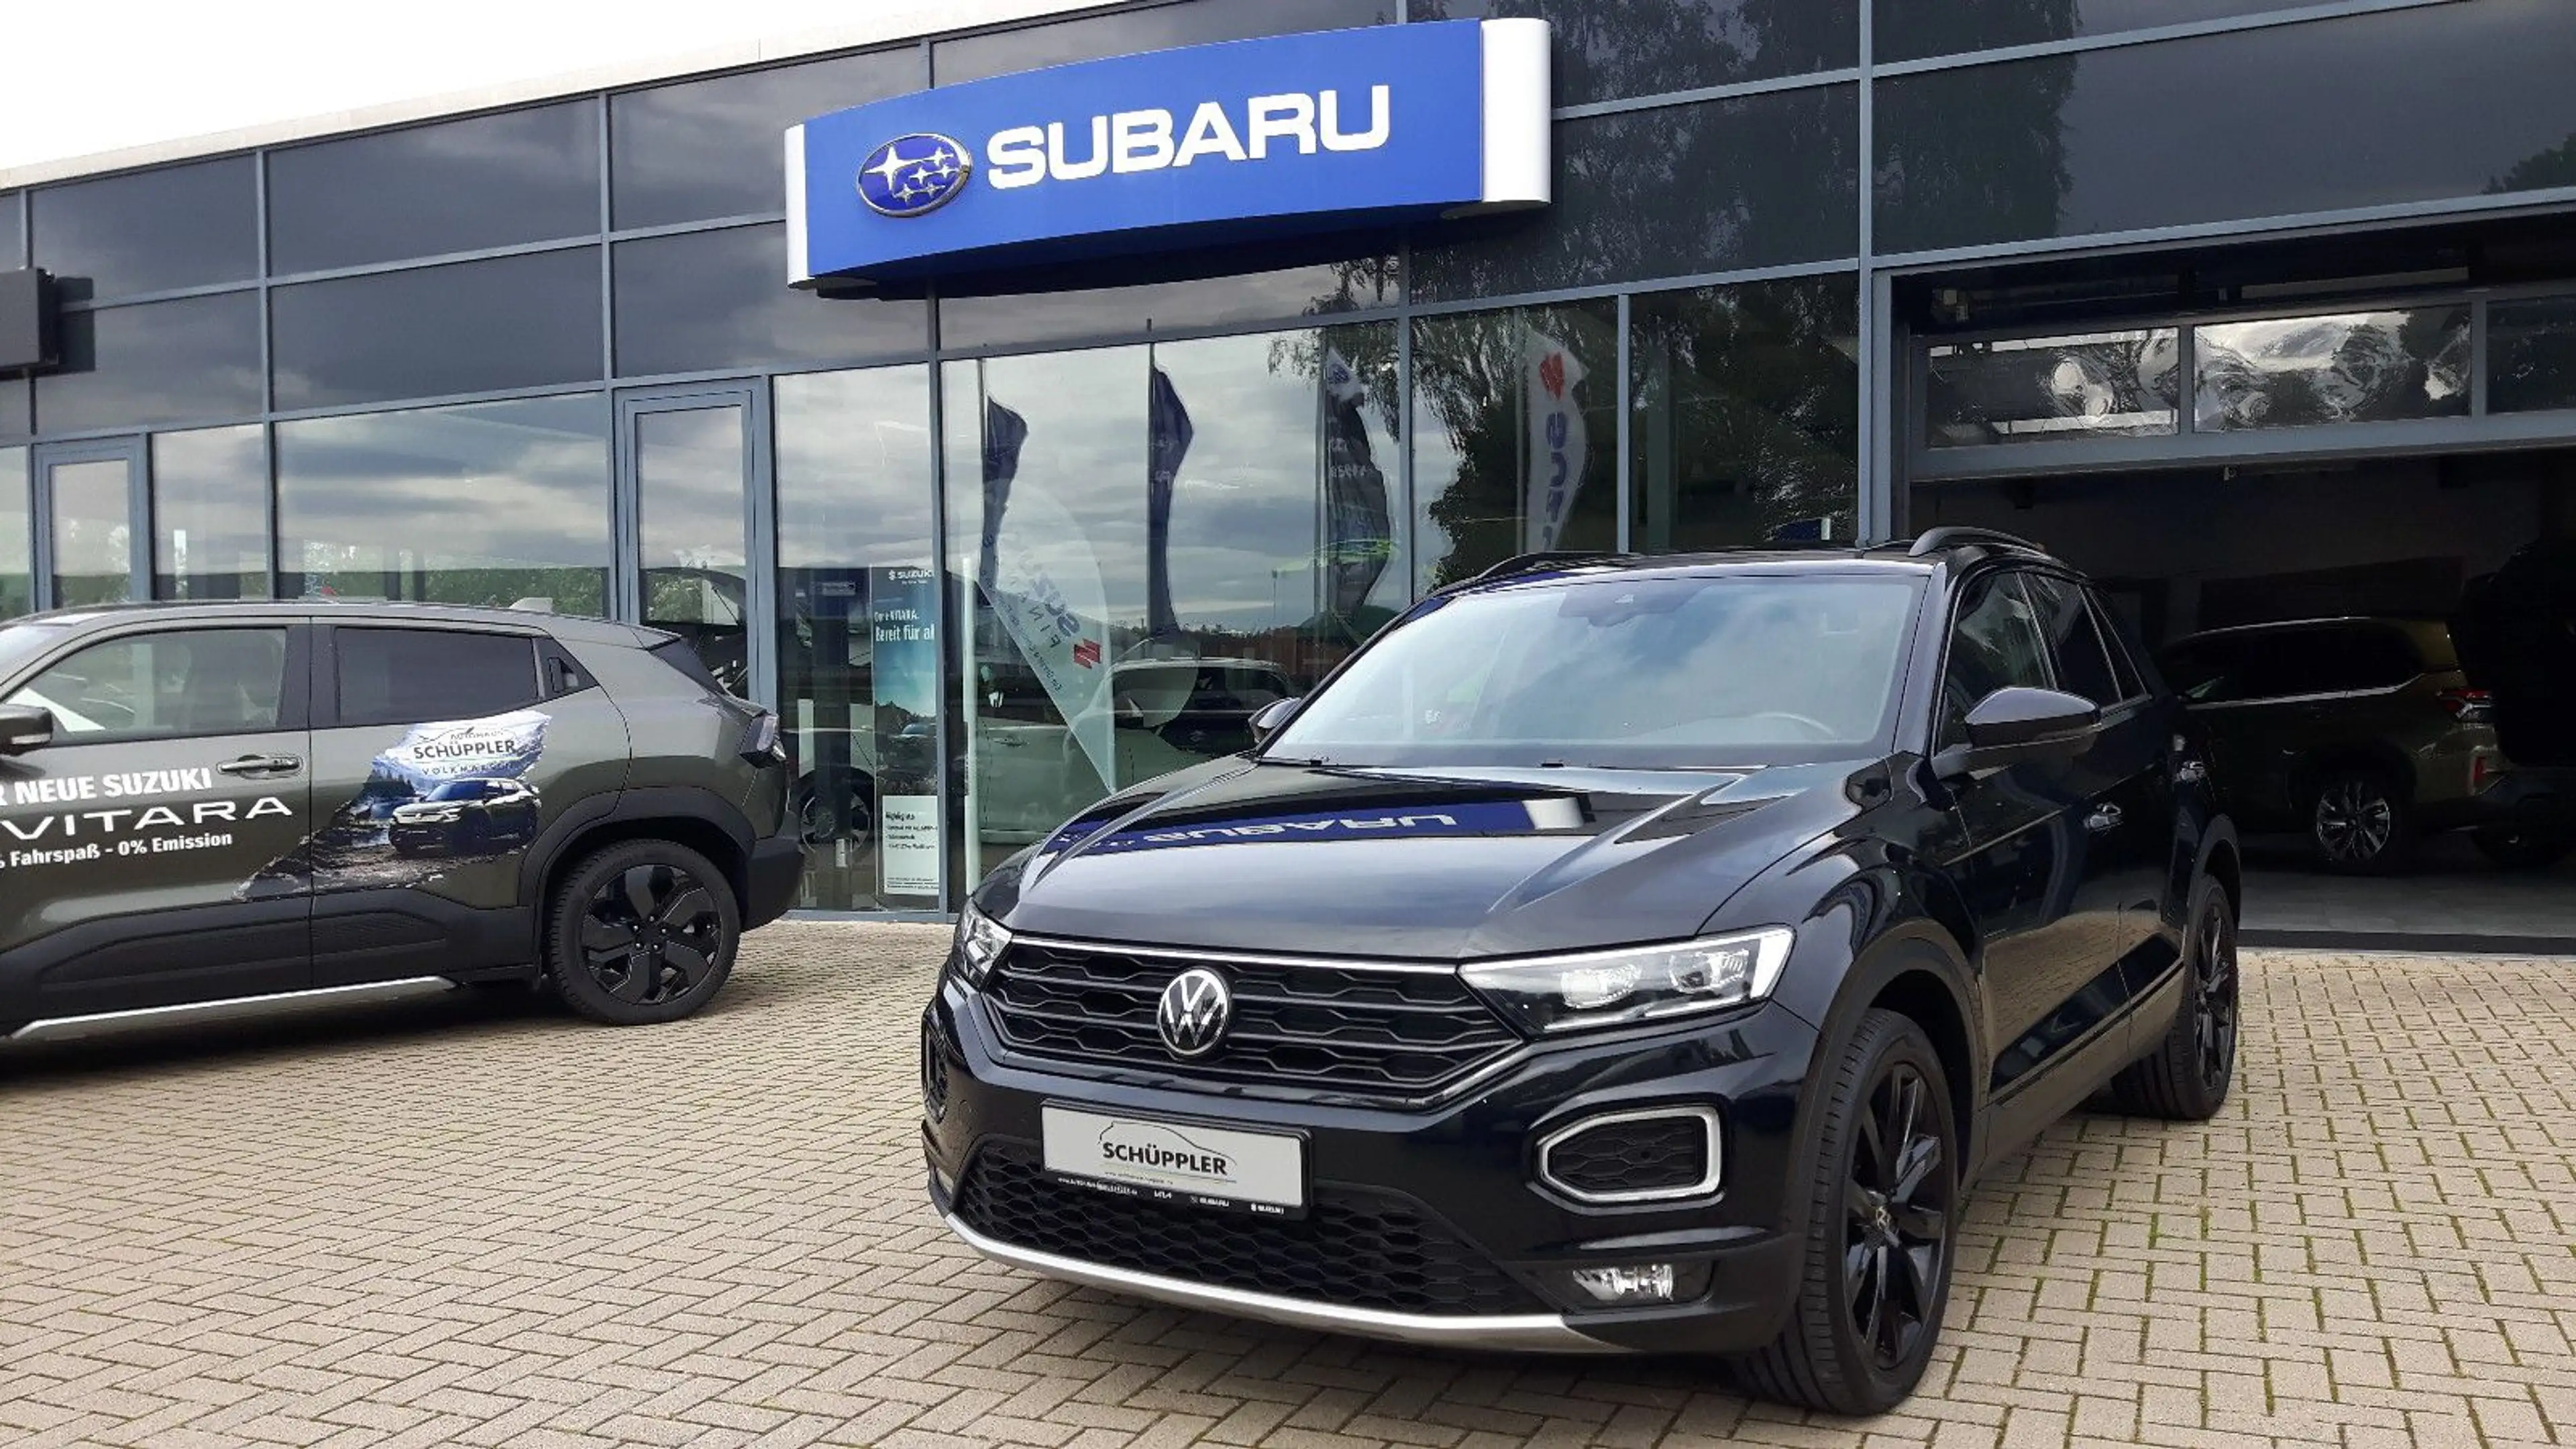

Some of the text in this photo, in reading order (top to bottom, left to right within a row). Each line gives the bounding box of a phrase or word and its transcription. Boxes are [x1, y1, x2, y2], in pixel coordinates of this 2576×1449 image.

[986, 85, 1390, 190] SUBARU
[875, 625, 901, 642] Bereit
[903, 624, 920, 641] für
[413, 740, 516, 759] SCHÜPPLER
[13, 775, 97, 805] NEUE
[102, 767, 213, 798] SUZUKI
[0, 796, 293, 841] VITARA
[10, 843, 101, 867] Fahrspaß
[117, 839, 148, 857] 0%
[152, 833, 233, 853] Emission
[1102, 1142, 1227, 1176] SCHÜPPLER
